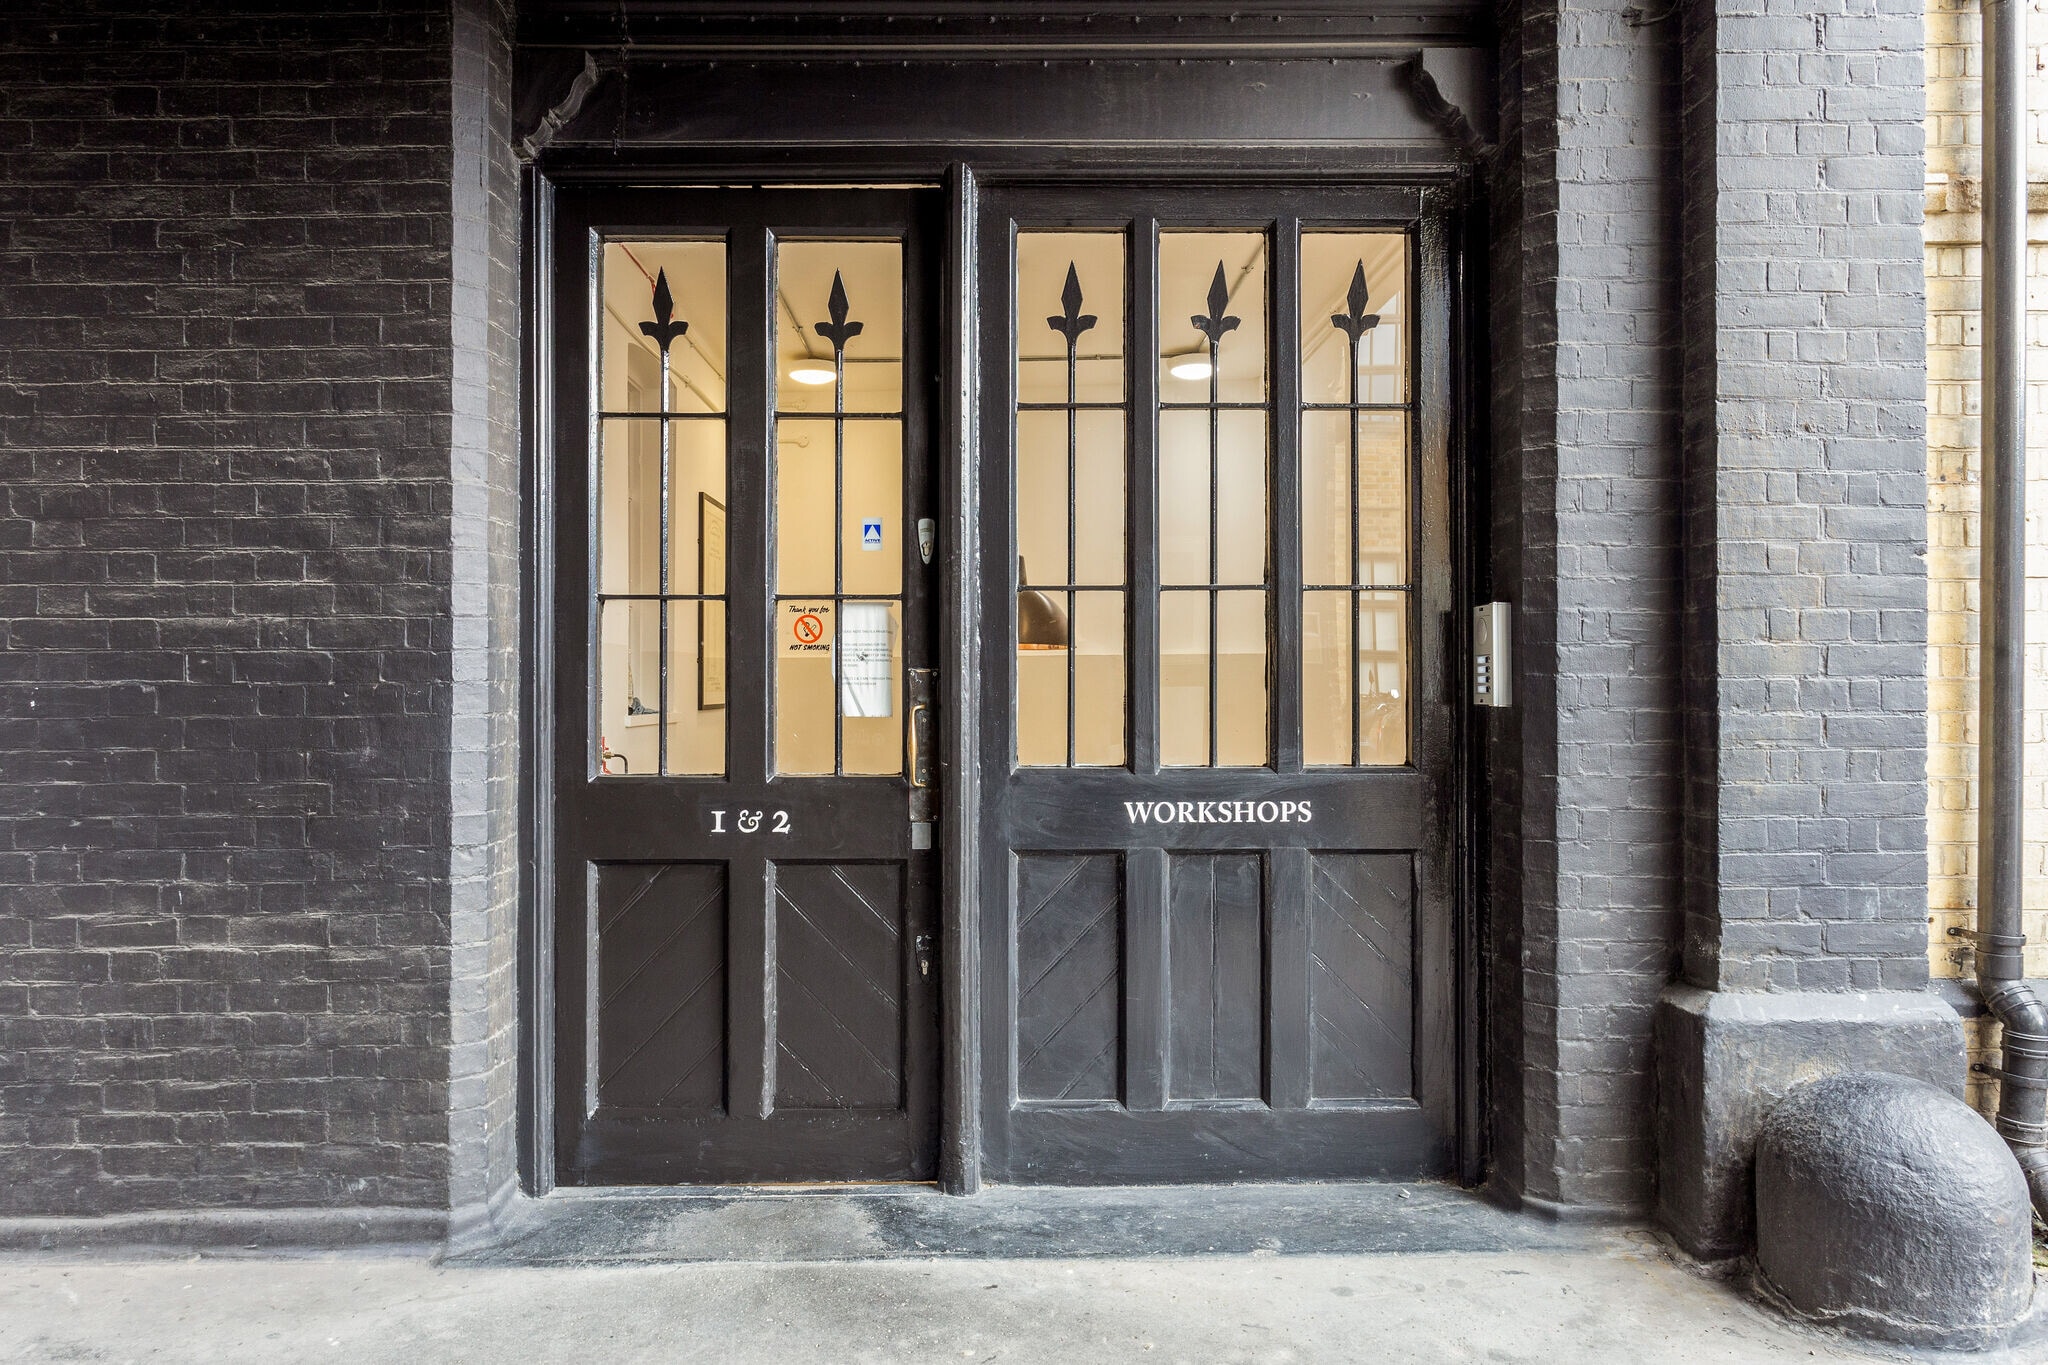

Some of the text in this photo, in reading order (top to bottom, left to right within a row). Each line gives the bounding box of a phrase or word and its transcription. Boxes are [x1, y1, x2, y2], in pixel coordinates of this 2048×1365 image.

[789, 605, 806, 614] Thank
[819, 605, 830, 614] for
[737, 809, 763, 834] &
[771, 810, 791, 834] 2
[1123, 800, 1312, 824] WORKSHOPS
